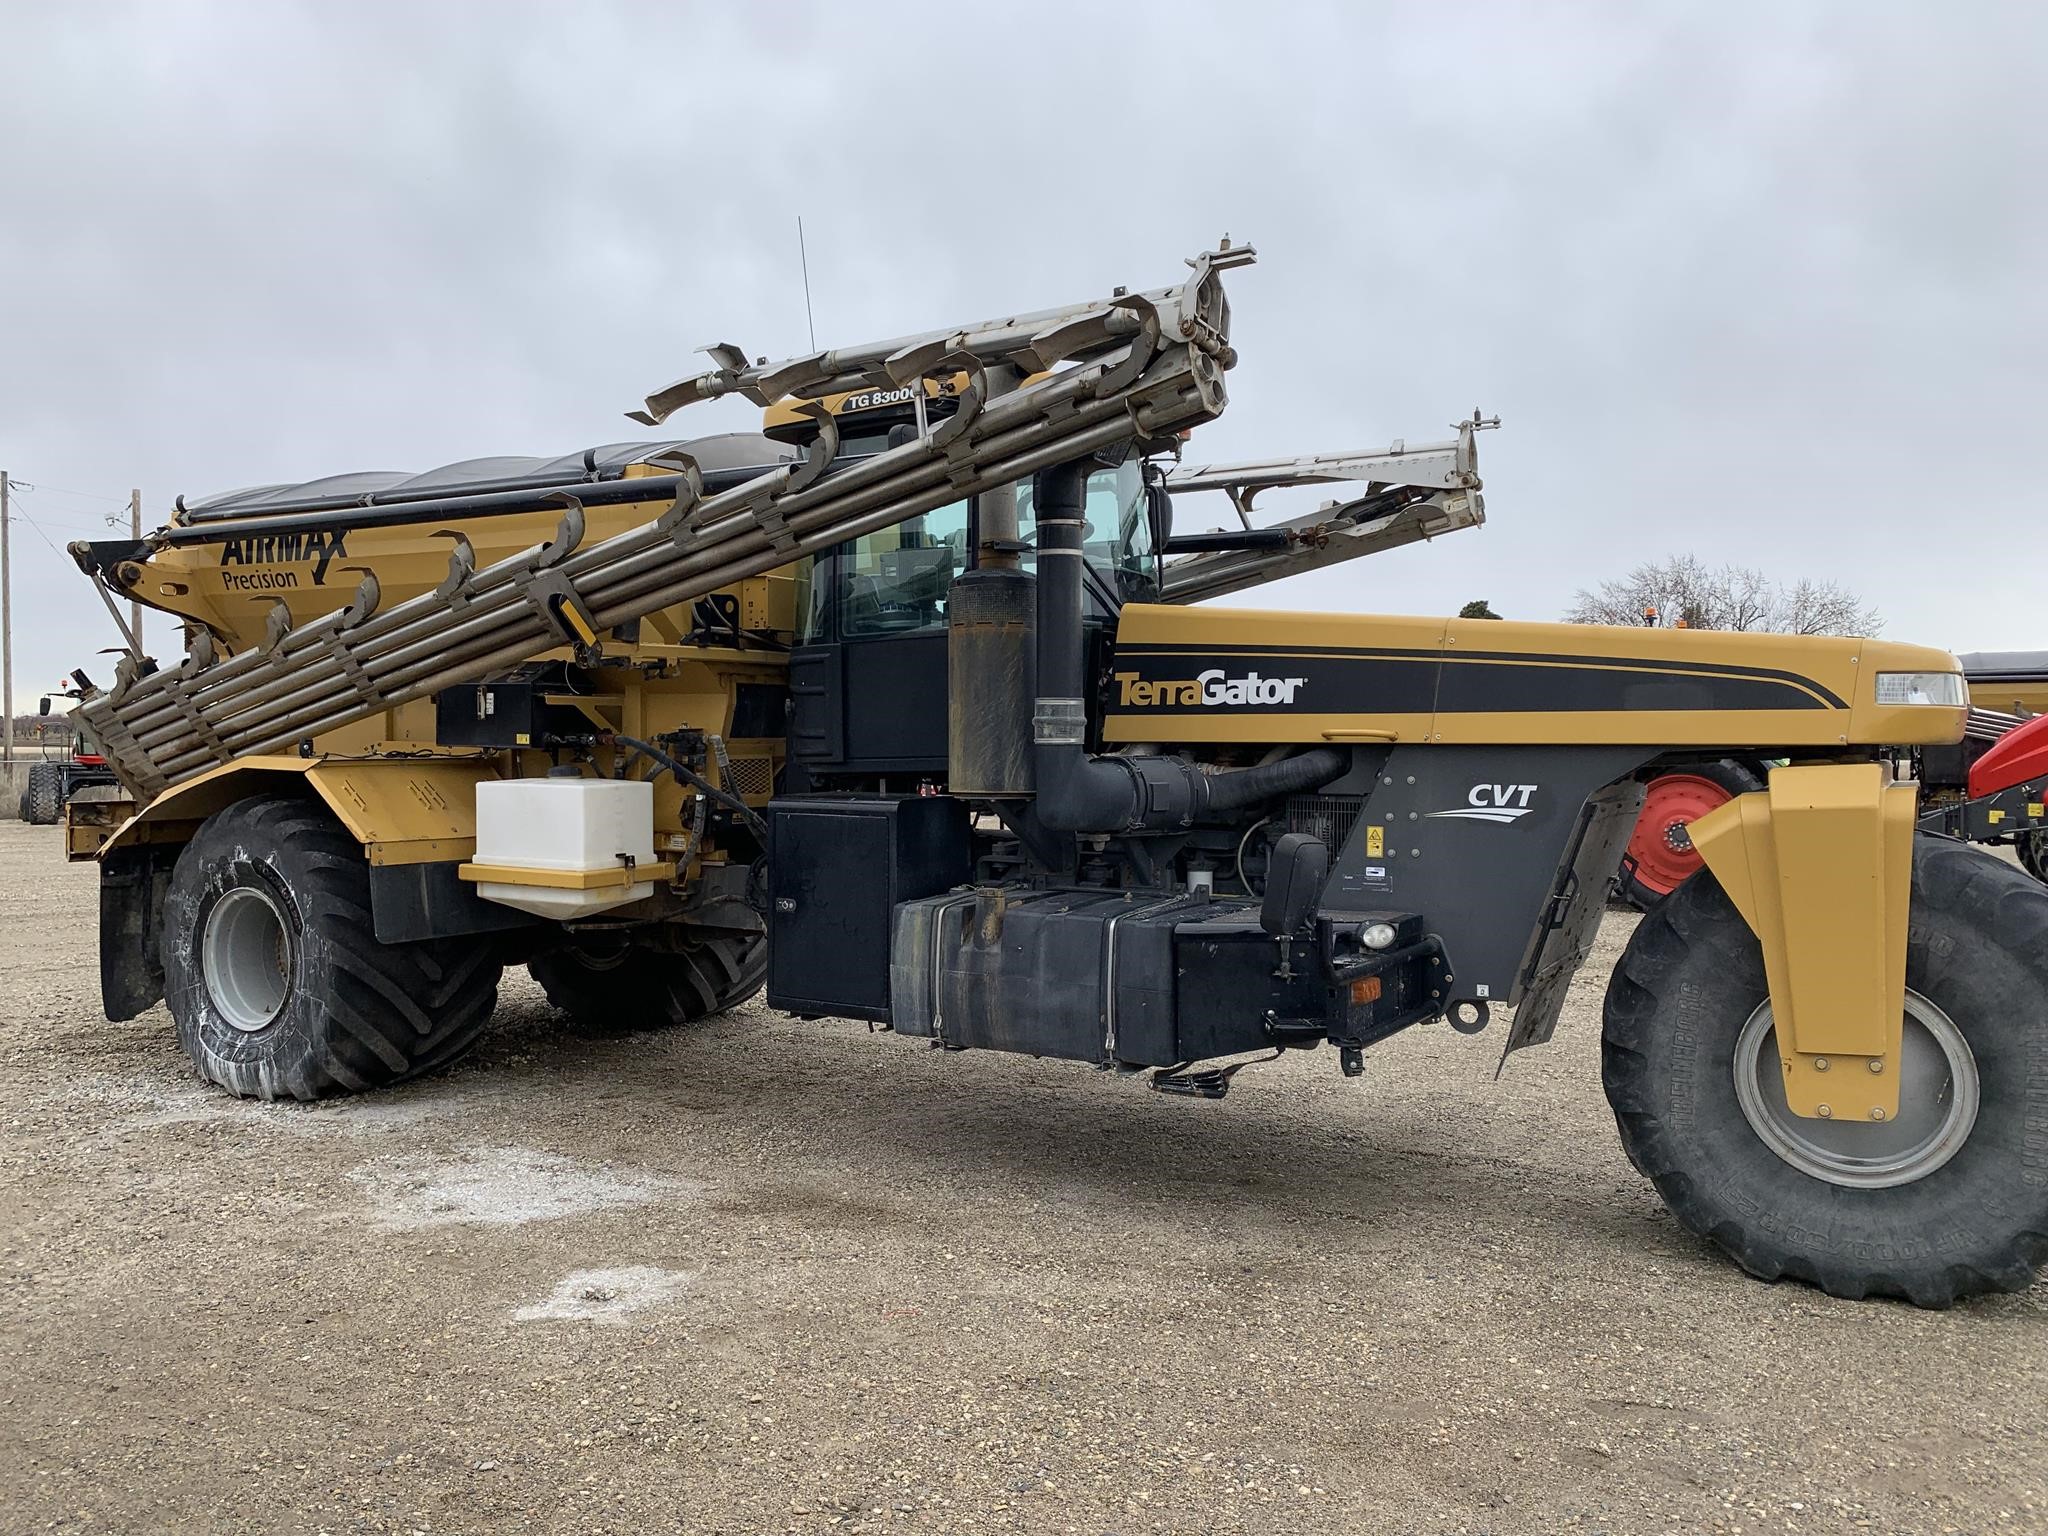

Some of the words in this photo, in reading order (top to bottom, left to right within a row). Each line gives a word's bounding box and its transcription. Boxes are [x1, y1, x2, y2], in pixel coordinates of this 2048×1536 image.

[849, 395, 870, 409] TG
[221, 529, 351, 575] AIRMAX
[222, 569, 298, 591] Precision
[1468, 783, 1538, 807] CVT
